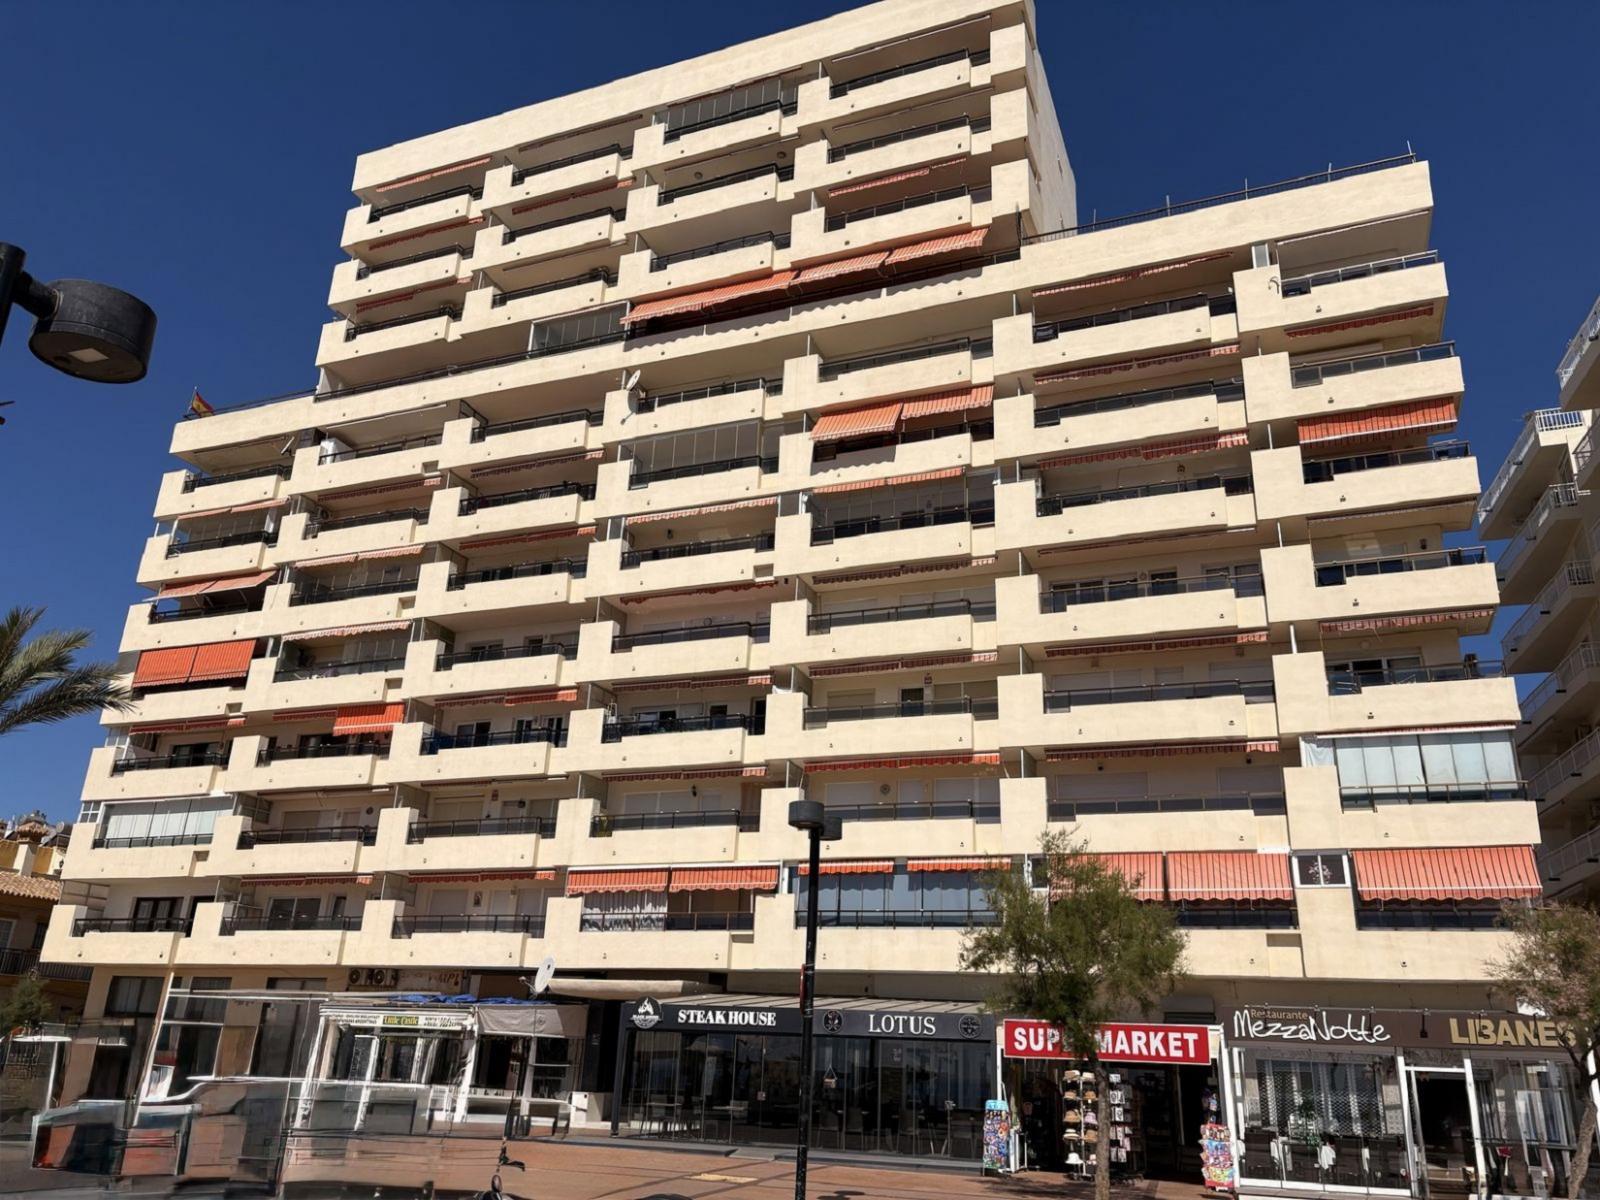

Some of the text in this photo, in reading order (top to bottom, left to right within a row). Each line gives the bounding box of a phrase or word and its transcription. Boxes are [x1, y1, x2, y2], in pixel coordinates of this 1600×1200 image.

[677, 1009, 776, 1026] STEAK HOUSE
[868, 1014, 937, 1035] LOTUS
[1250, 1009, 1308, 1020] Restaurante
[1013, 1027, 1199, 1058] SUPMARKET
[1449, 1017, 1577, 1047] LIBANES
